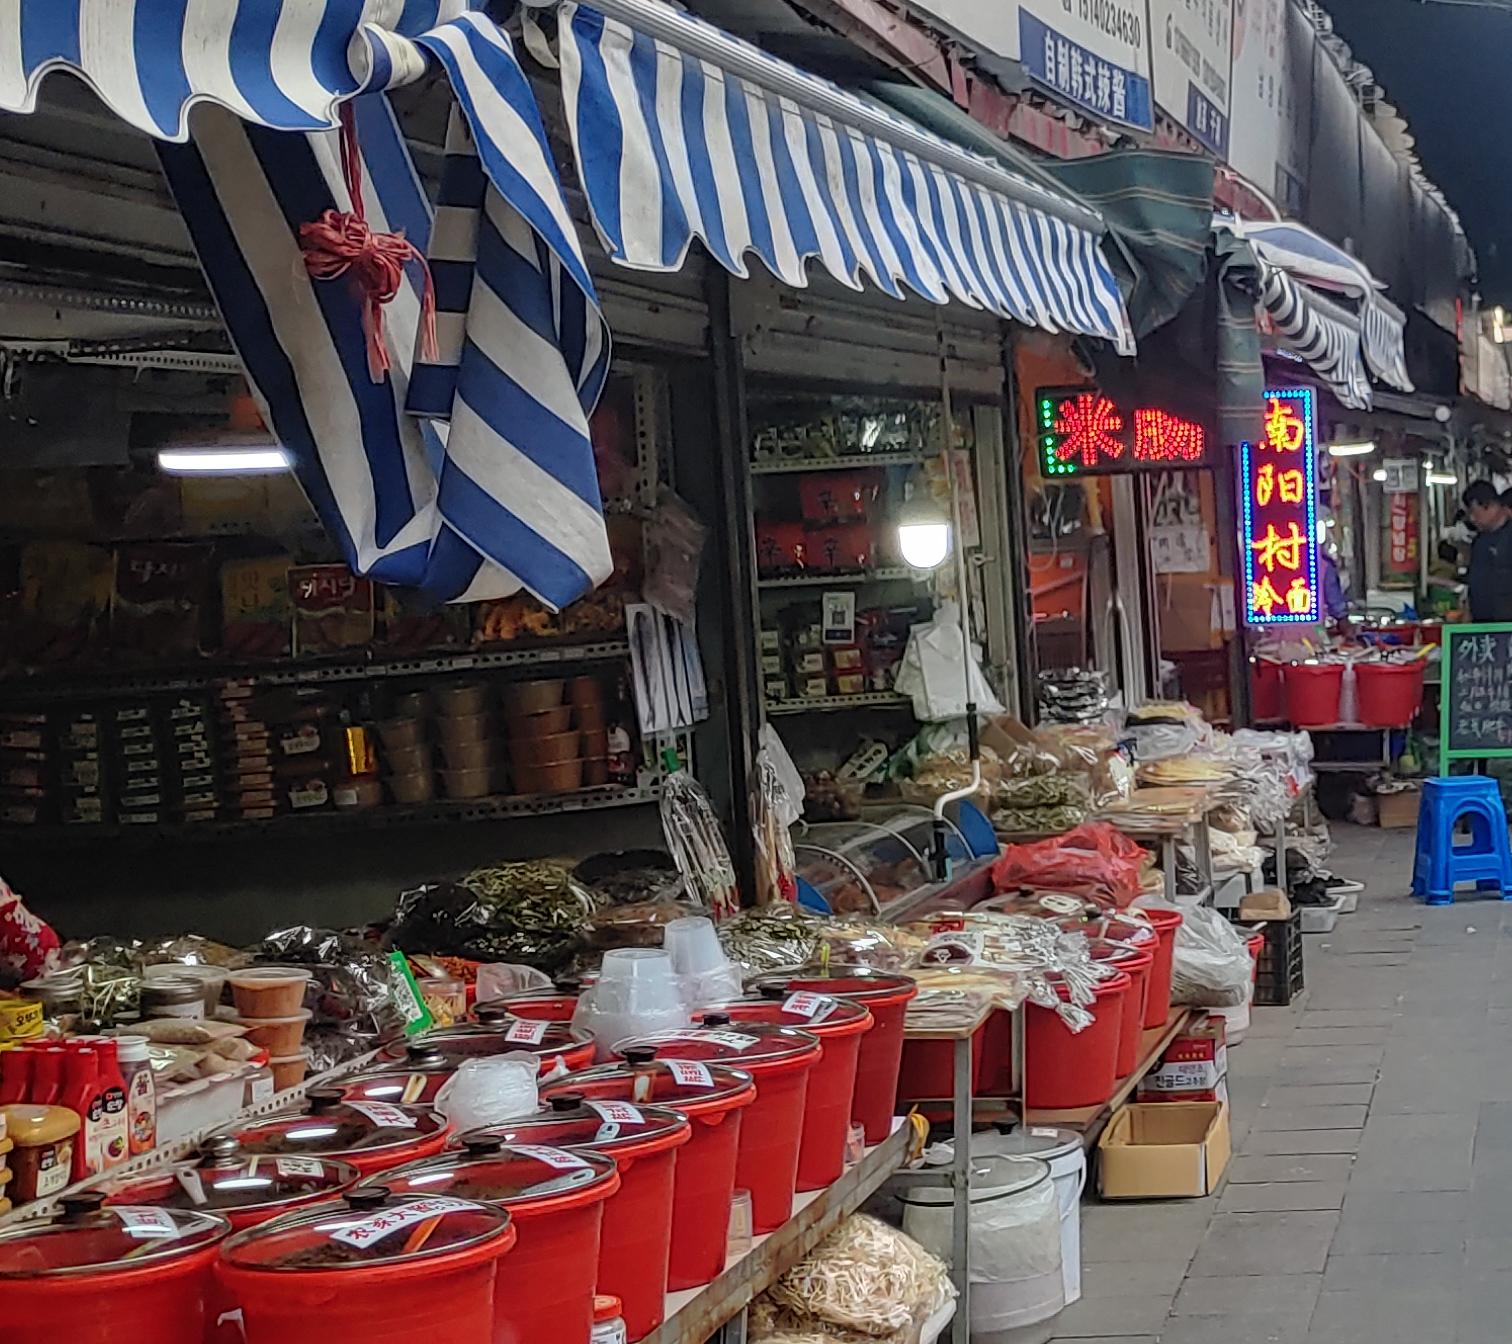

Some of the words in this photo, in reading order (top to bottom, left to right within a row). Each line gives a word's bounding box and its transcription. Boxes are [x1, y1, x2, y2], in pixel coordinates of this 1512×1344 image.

[1044, 29, 1126, 120] 自制韩式辣酱
[1252, 396, 1307, 572] 南阳村
[1253, 575, 1312, 617] 冷面
